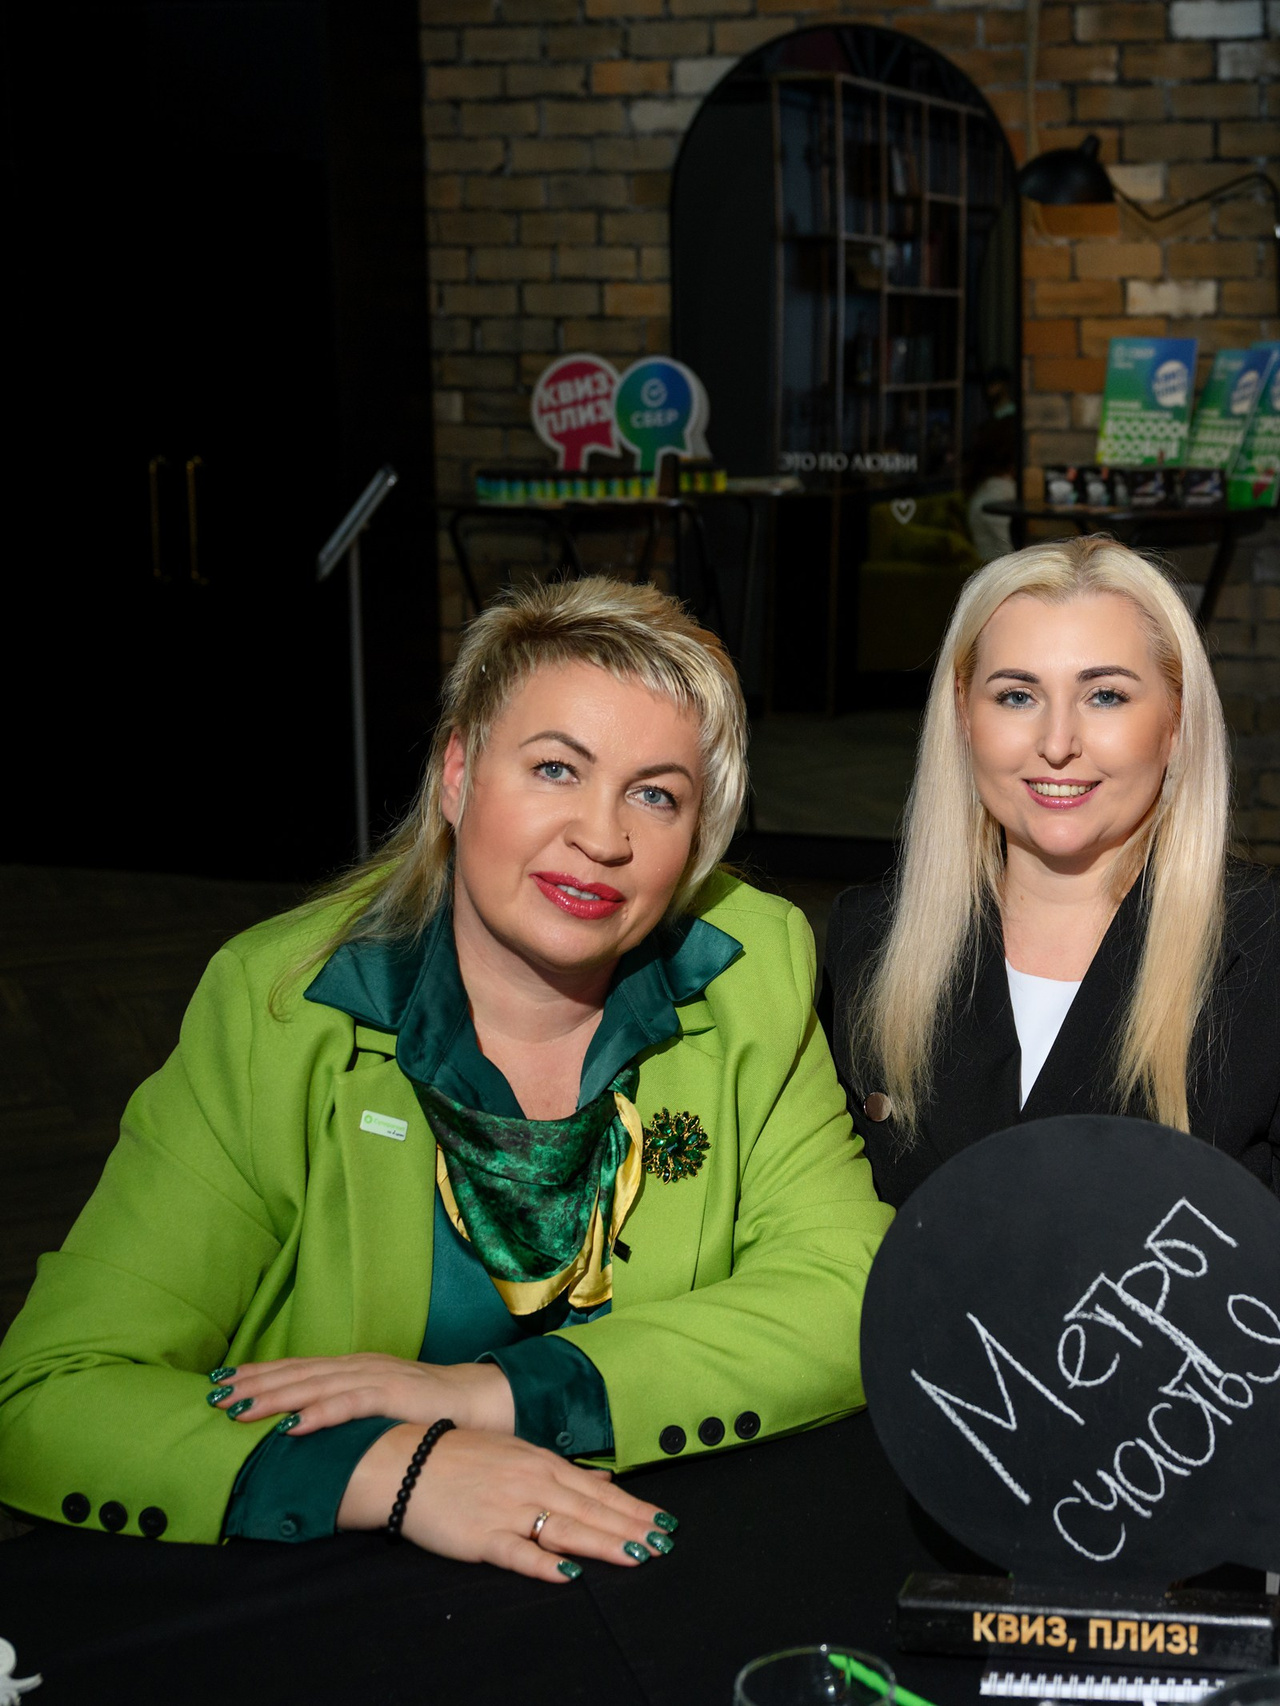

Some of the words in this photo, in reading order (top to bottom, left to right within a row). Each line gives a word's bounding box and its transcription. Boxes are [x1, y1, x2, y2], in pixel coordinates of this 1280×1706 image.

[539, 371, 609, 408] КВИЗ
[630, 408, 680, 429] СБЕР
[779, 451, 817, 473] ЭТО
[818, 451, 849, 473] ПО
[972, 1611, 1077, 1653] КВИЗ,
[1088, 1617, 1199, 1656] ПЛИЗ!
